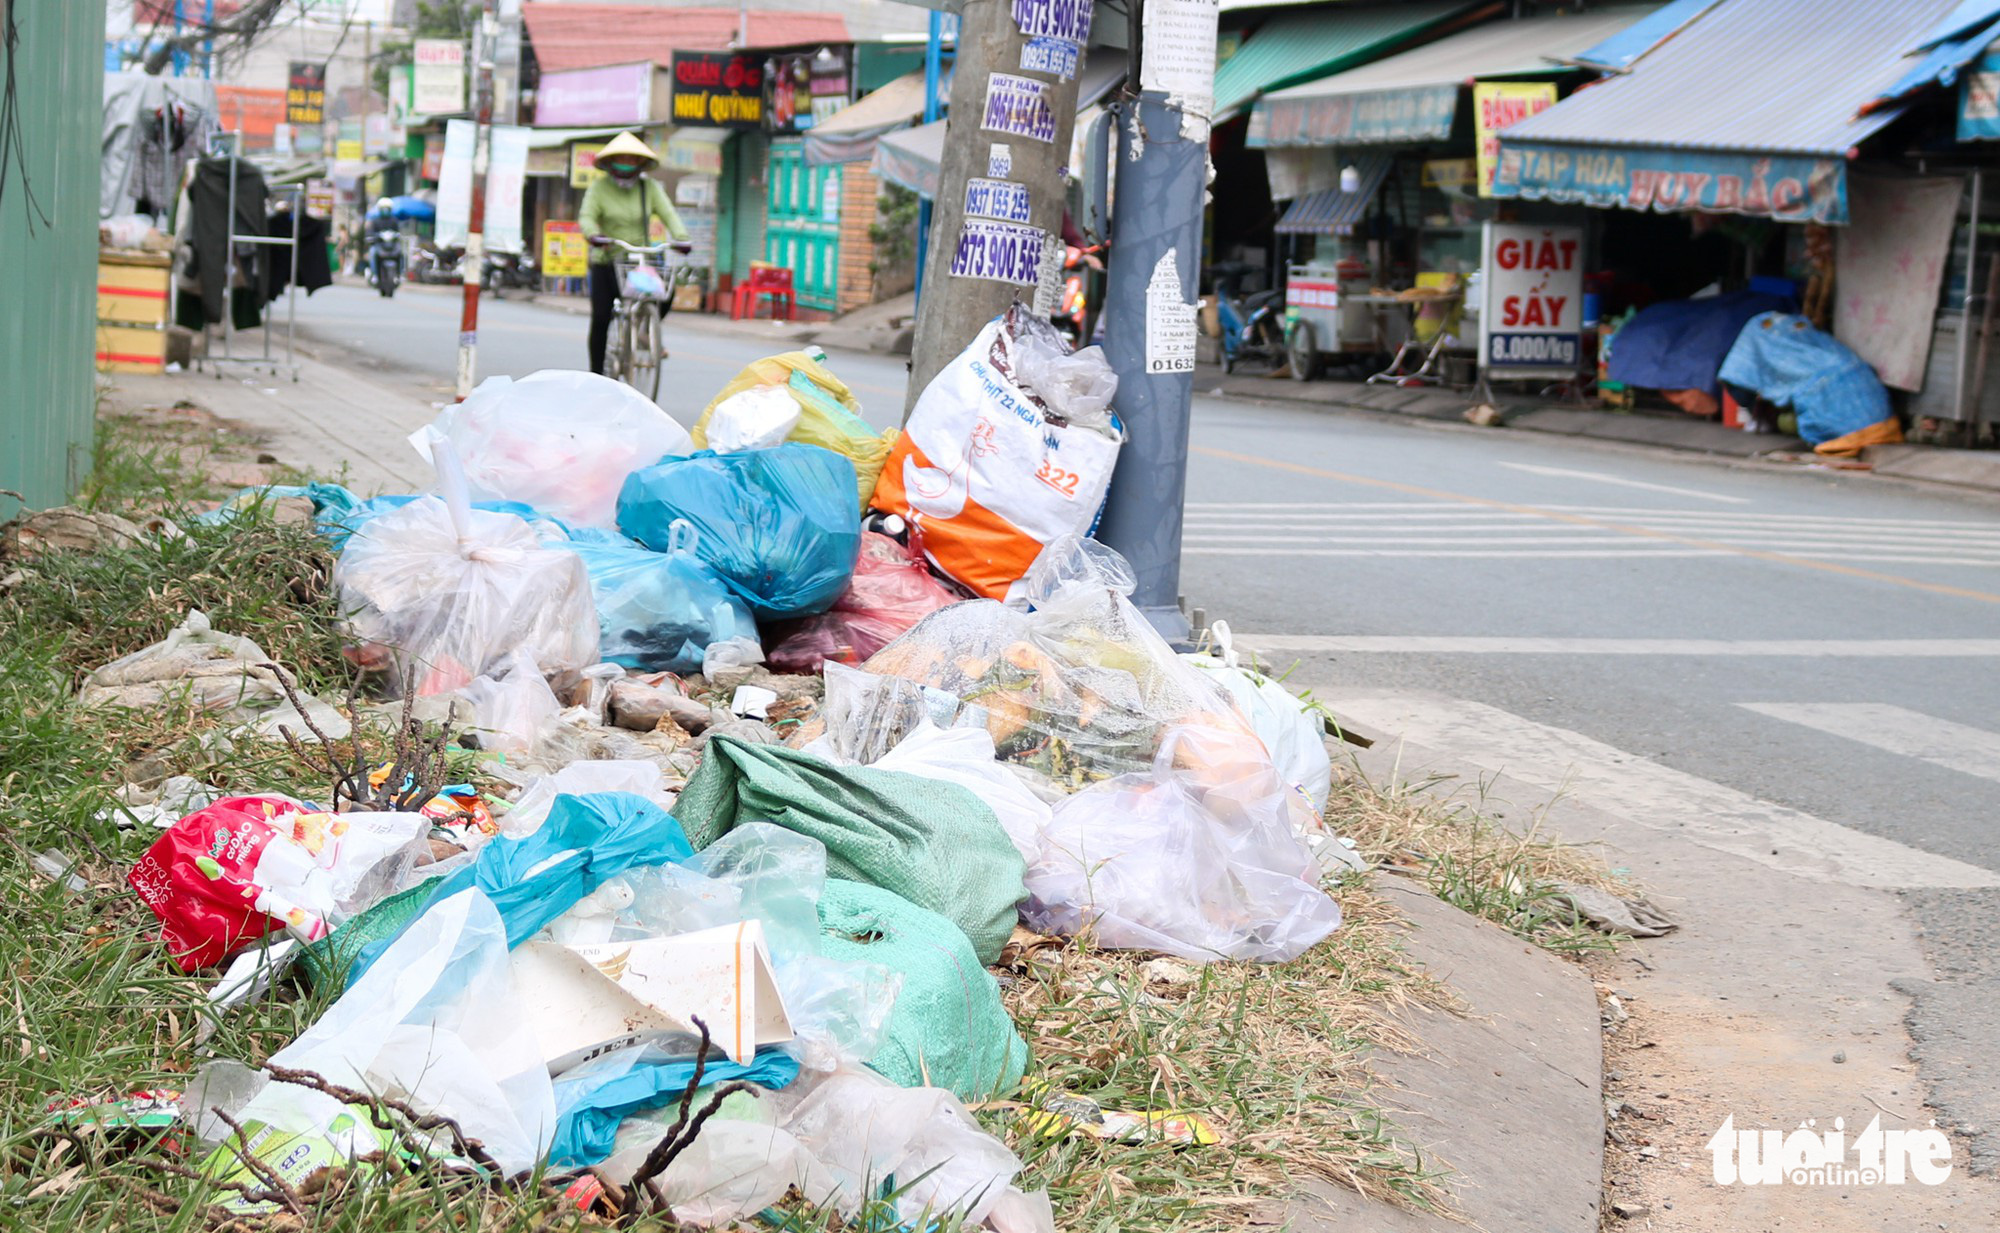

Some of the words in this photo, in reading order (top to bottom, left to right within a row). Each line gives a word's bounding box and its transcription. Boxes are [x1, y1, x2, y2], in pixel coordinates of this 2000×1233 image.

[676, 55, 721, 85] QUÁN
[1628, 169, 1713, 214] HUY
[1715, 158, 1807, 217] BẮC
[1496, 230, 1578, 278] GIẶT
[1502, 279, 1567, 328] SẤY
[1491, 335, 1575, 365] 8.000/kg
[1000, 394, 1015, 410] 22
[1037, 459, 1080, 497] 322
